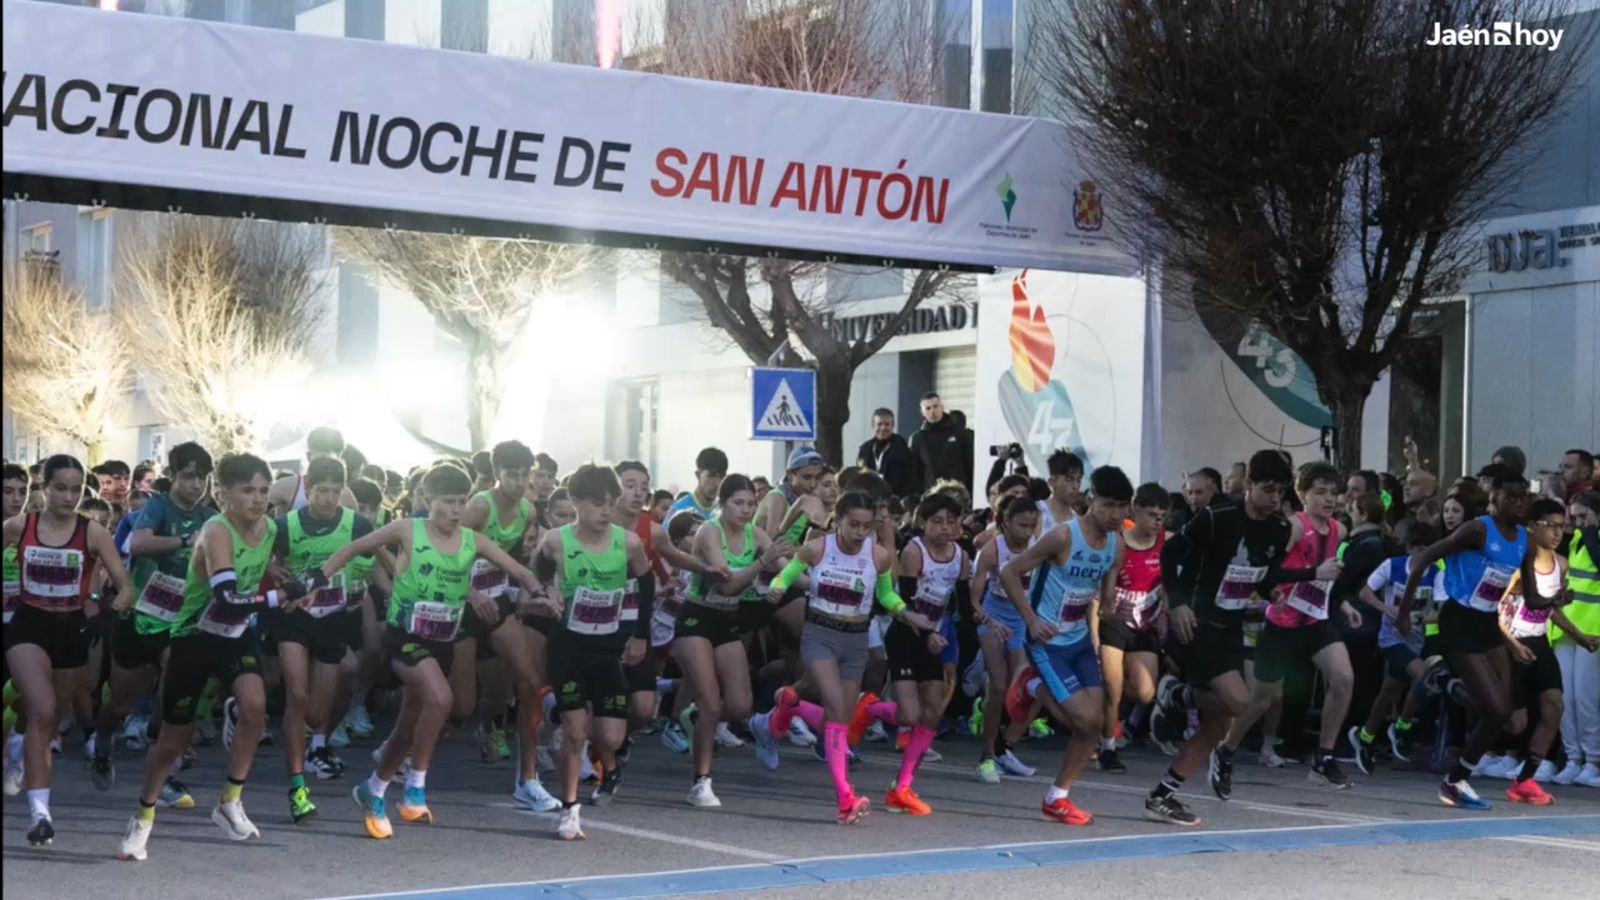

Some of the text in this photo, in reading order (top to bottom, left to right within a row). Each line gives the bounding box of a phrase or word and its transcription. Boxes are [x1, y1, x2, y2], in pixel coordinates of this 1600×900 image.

[3, 71, 950, 225] ACIONAL NOCHE DE SAN ANTÓN
[1070, 564, 1105, 582] nerj
